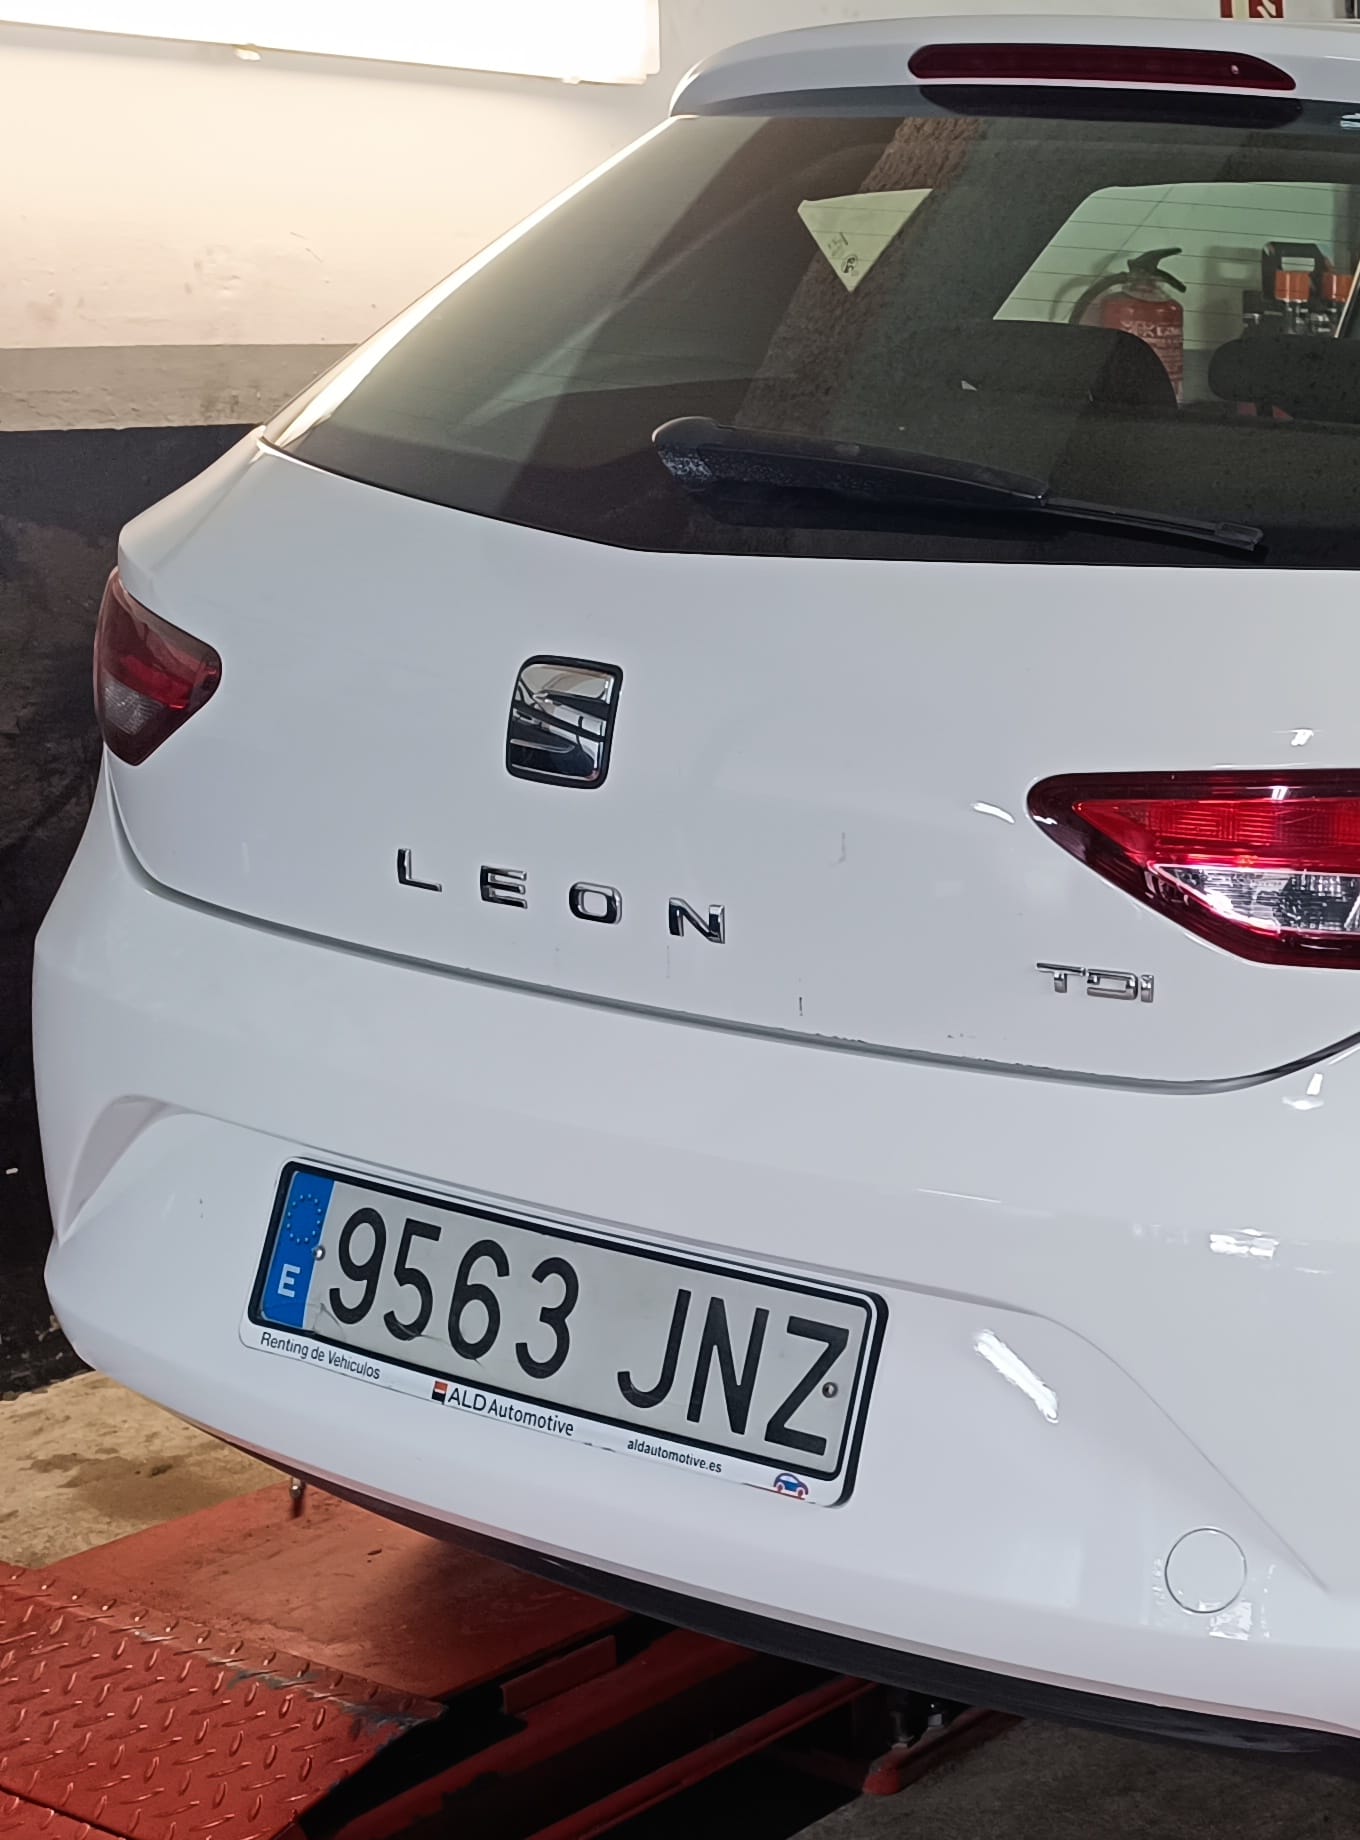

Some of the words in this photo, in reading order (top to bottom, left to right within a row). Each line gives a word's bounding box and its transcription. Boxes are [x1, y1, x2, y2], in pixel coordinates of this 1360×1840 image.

[397, 847, 727, 945] LEON
[1035, 962, 1155, 1003] TDI
[277, 1263, 302, 1299] E
[260, 1332, 309, 1359] Renting
[310, 1345, 325, 1363] de
[328, 1206, 580, 1380] 9563
[617, 1288, 851, 1457] JNZ
[447, 1387, 487, 1413] ALD
[487, 1396, 575, 1437] Automotive
[626, 1439, 722, 1473] aldautomotive.es
